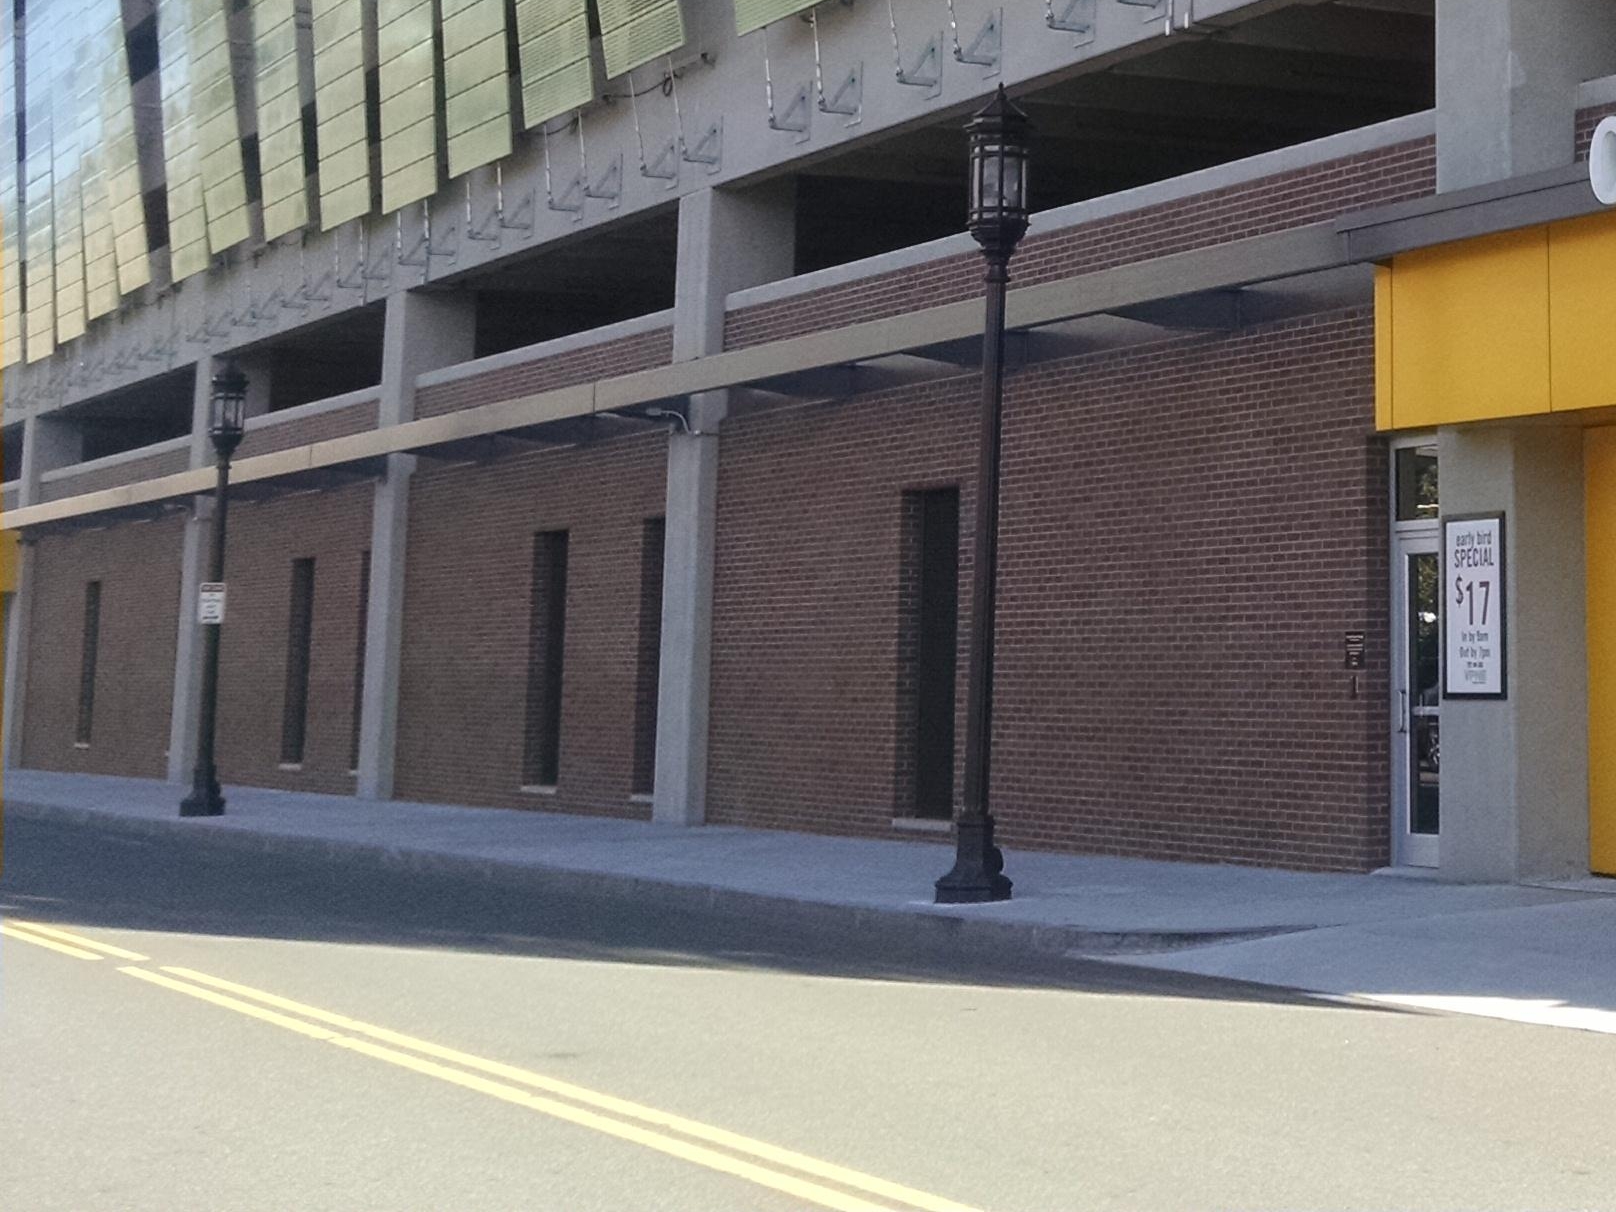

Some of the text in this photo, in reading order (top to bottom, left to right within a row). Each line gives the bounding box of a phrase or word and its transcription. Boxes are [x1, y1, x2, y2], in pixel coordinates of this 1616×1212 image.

[1456, 530, 1492, 548] early bird
[1454, 547, 1495, 568] SPECIAL
[1455, 573, 1490, 625] $17
